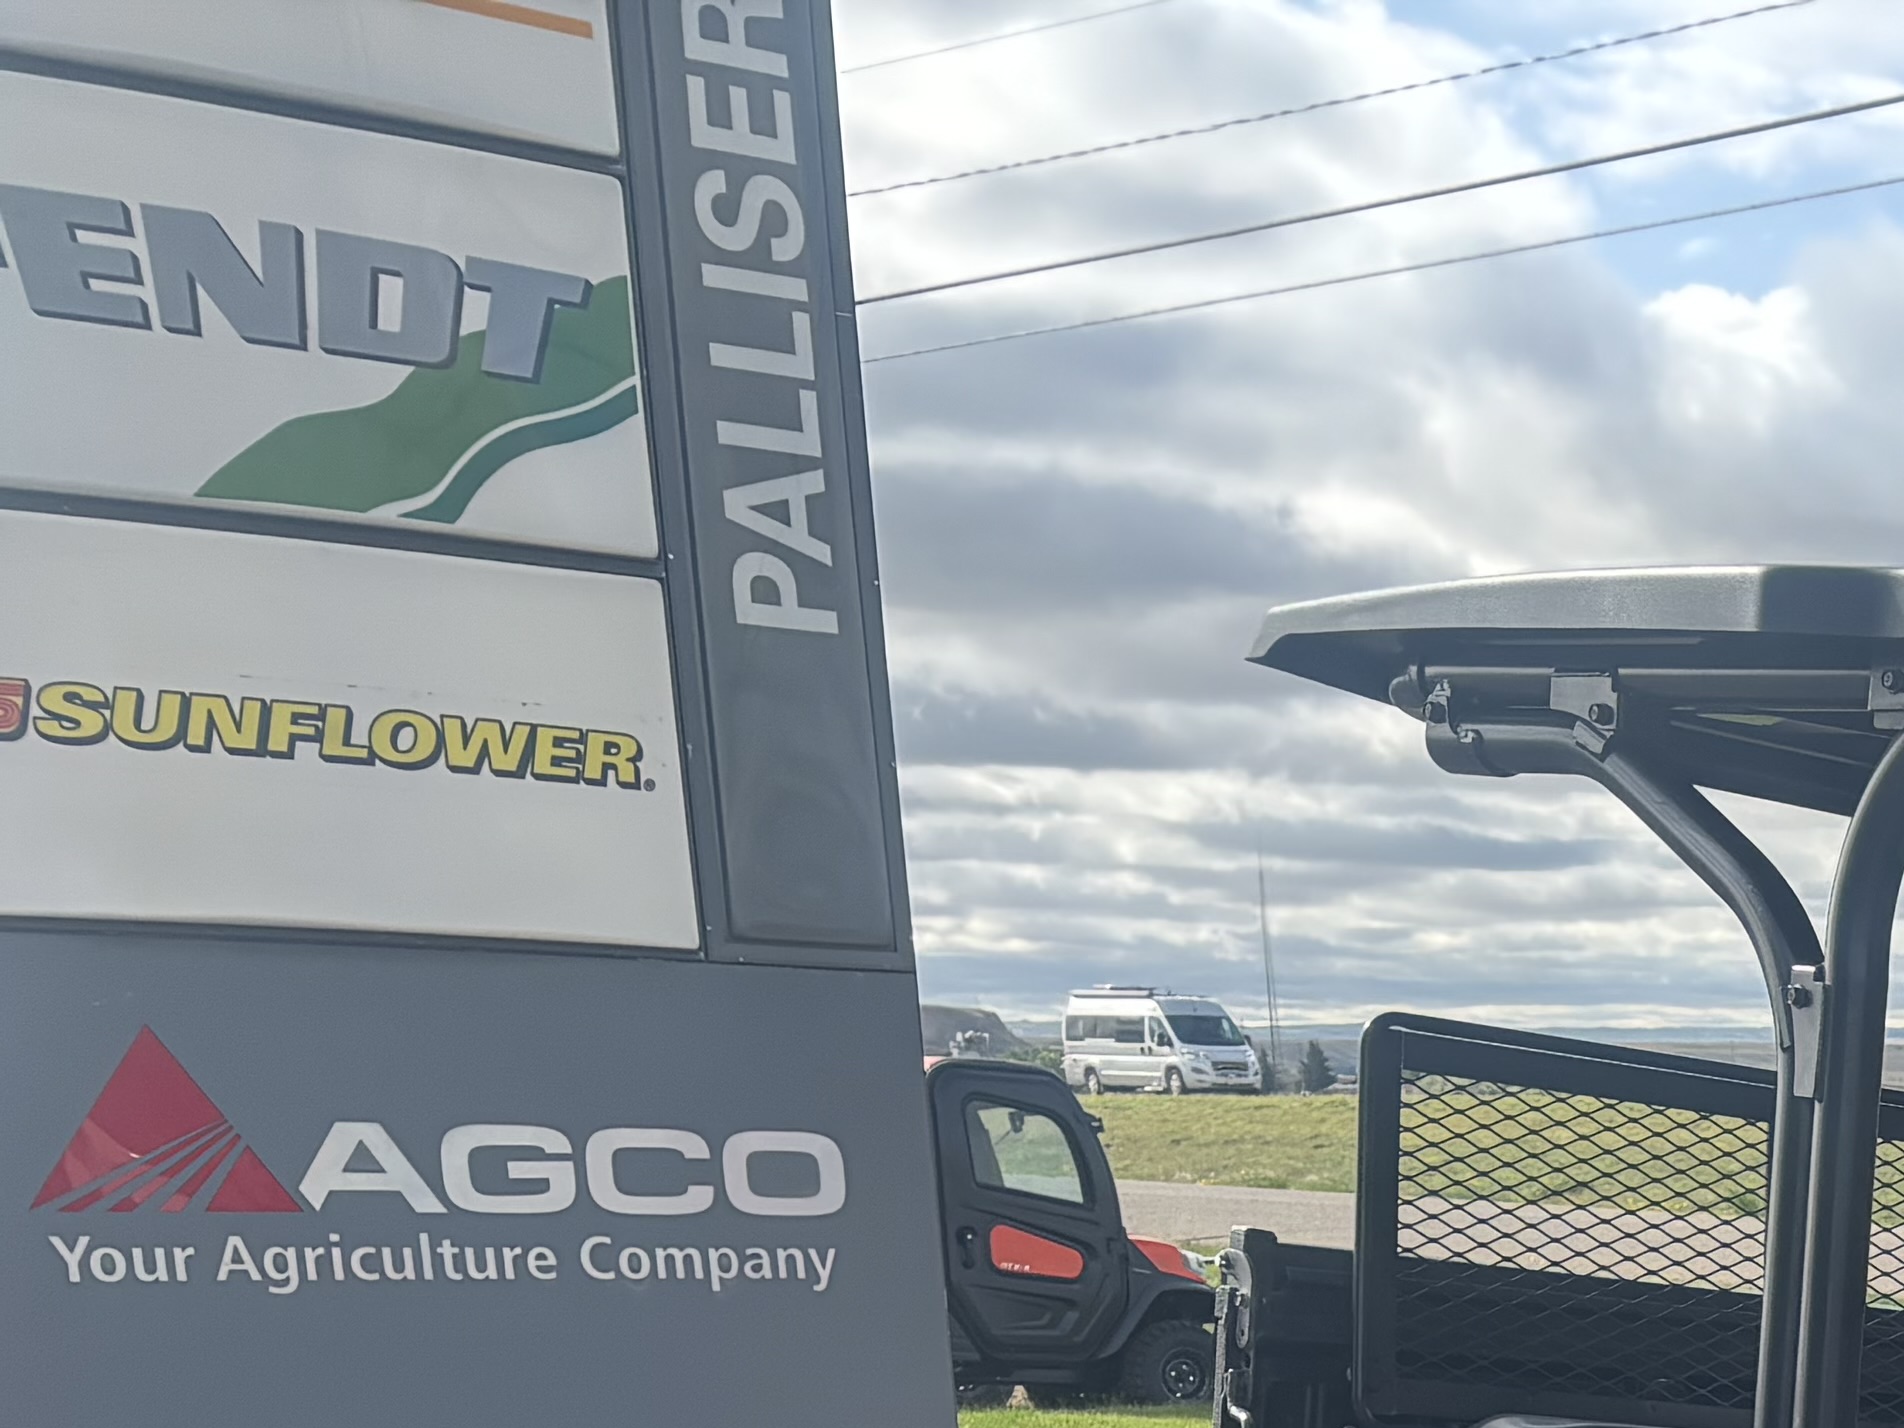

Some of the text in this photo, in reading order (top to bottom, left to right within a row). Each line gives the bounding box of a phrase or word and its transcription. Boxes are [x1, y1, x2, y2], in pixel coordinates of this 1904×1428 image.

[0, 184, 591, 383] ENDT
[682, 0, 840, 635] PALLISER
[298, 1121, 847, 1217] AGCO
[49, 1232, 837, 1294] Your Agriculture Company
